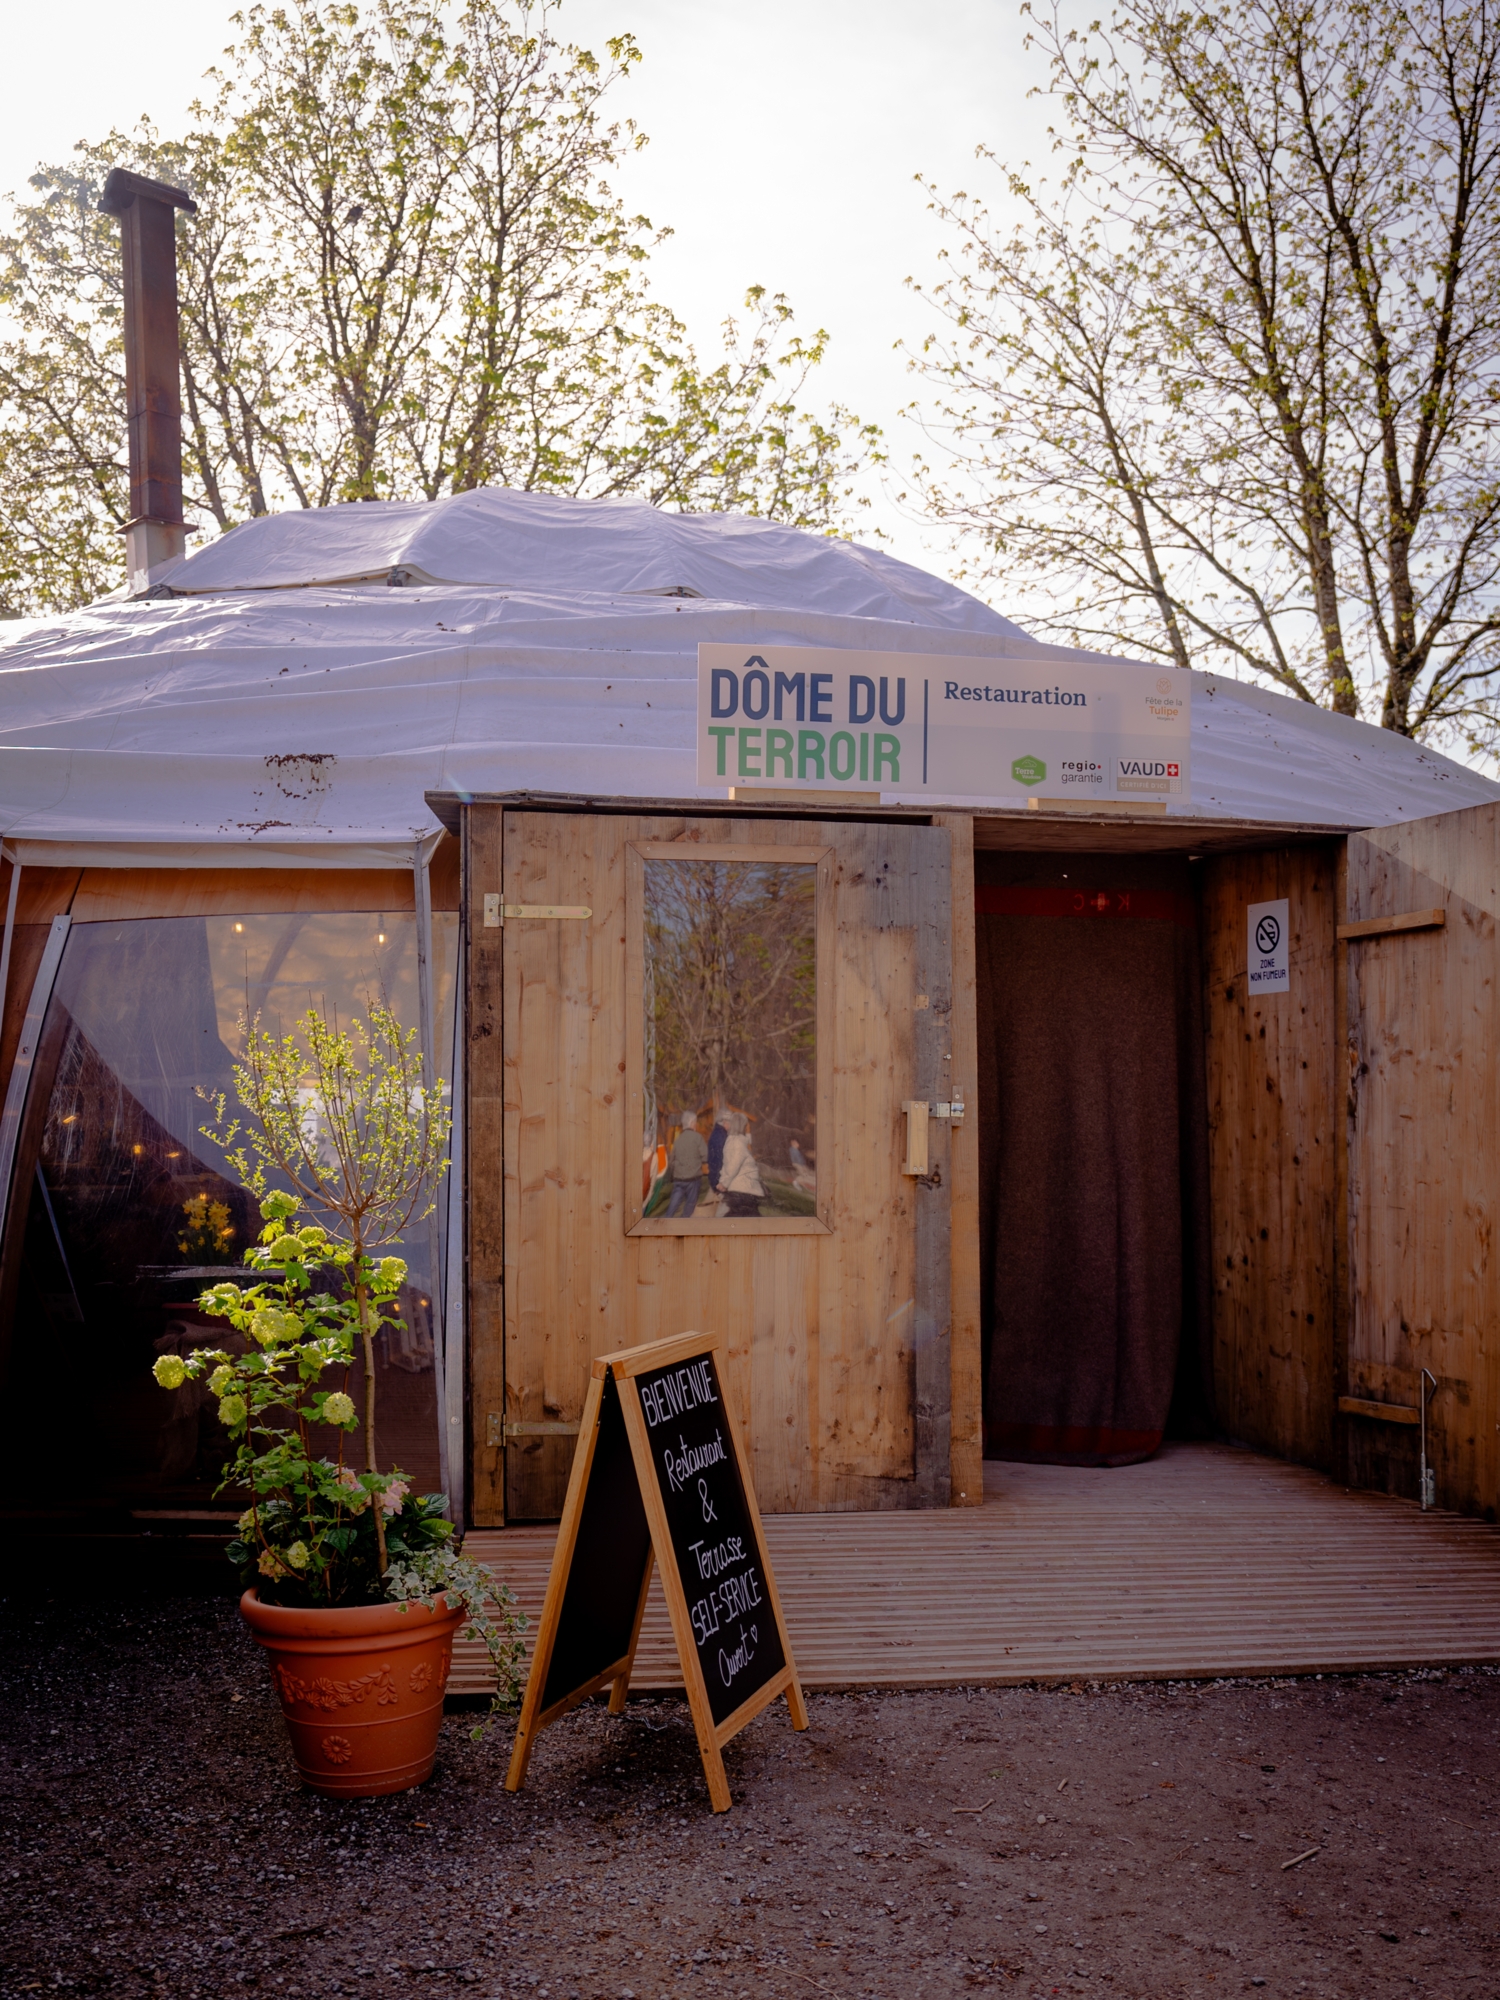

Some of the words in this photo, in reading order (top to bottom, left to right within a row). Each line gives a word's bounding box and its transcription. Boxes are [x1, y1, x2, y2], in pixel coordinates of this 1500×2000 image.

[711, 655, 833, 723] DÔME
[848, 674, 906, 726] DU
[944, 681, 1087, 706] Restauration
[1145, 696, 1162, 706] Fête
[1163, 698, 1174, 706] de
[1175, 699, 1183, 707] la
[1149, 705, 1179, 717] Tulipe
[708, 726, 901, 783] TERROIR
[1015, 767, 1035, 775] Terre
[1061, 773, 1103, 784] garantie
[1120, 761, 1166, 776] VAUD
[1250, 971, 1262, 982] NON
[1263, 969, 1286, 981] FUMEUR
[1260, 958, 1275, 969] ZONE
[641, 1360, 718, 1427] BIENVENUE
[664, 1428, 727, 1492] Restaurant
[698, 1478, 718, 1523] &
[688, 1536, 747, 1580] Terrasse
[691, 1567, 762, 1646] SELF-SERVICE
